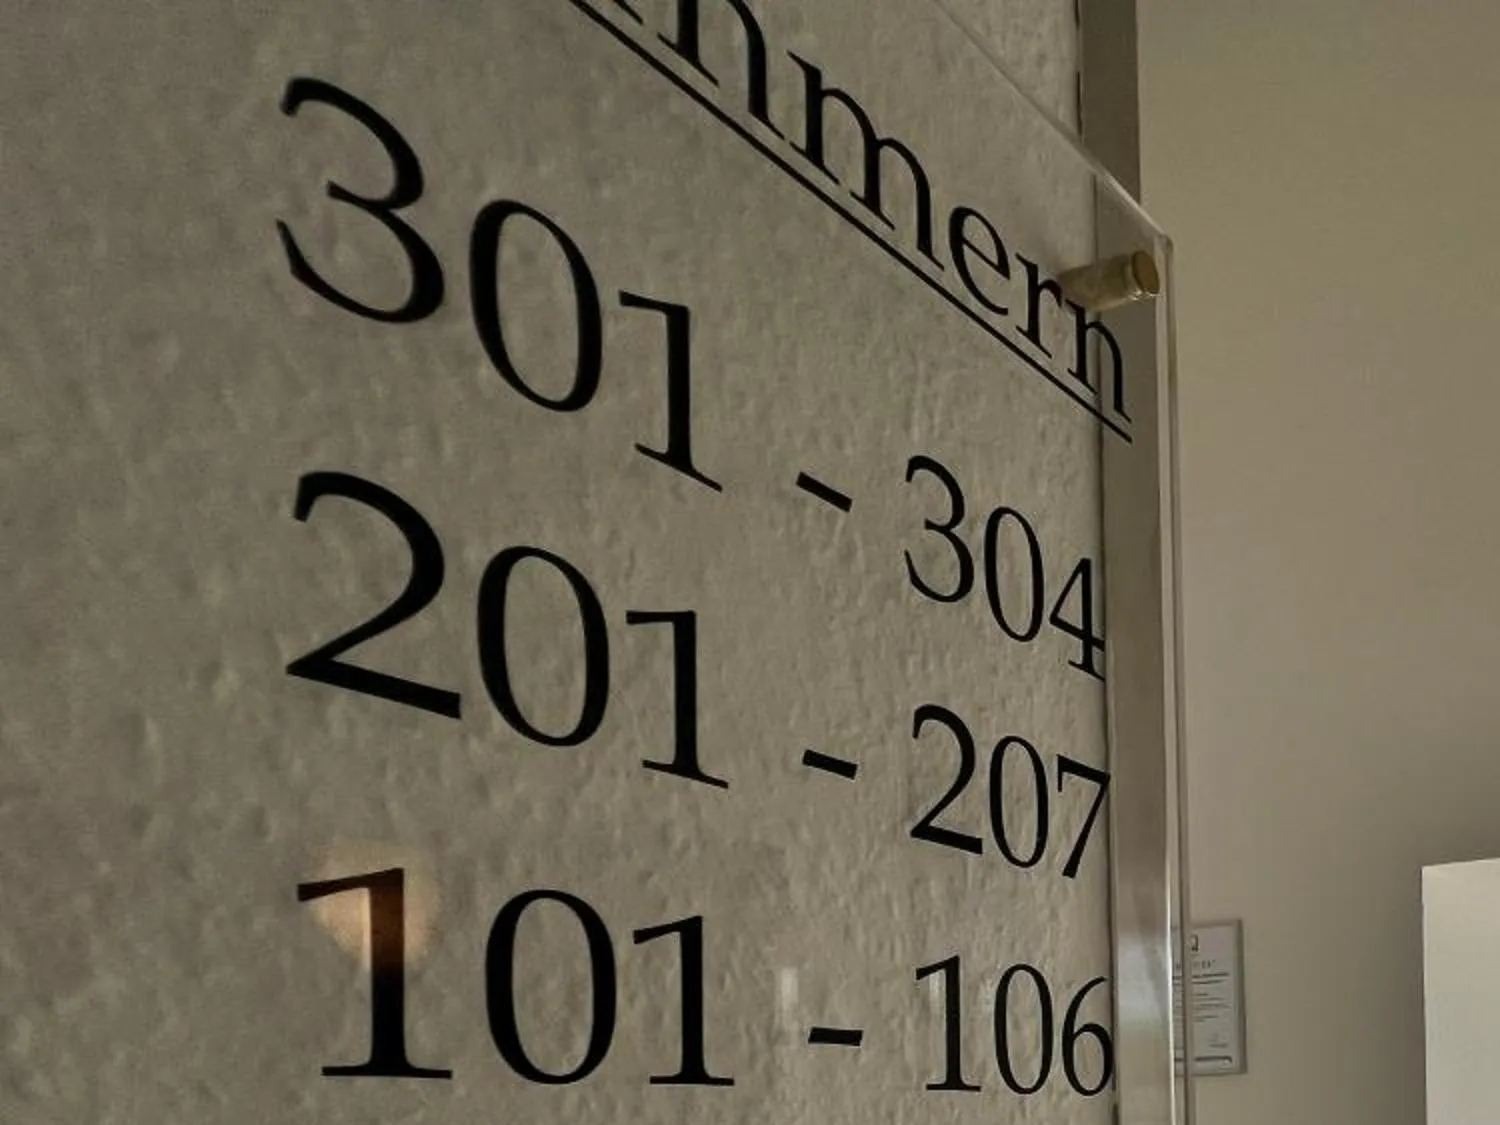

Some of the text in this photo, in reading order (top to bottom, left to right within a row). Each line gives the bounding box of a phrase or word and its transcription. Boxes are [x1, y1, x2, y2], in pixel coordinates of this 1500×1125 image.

[276, 77, 1105, 681] 301 - 304
[286, 471, 1110, 879] 201 - 207
[297, 867, 735, 1086] 101
[808, 1027, 864, 1046] -
[916, 955, 1114, 1096] 106
